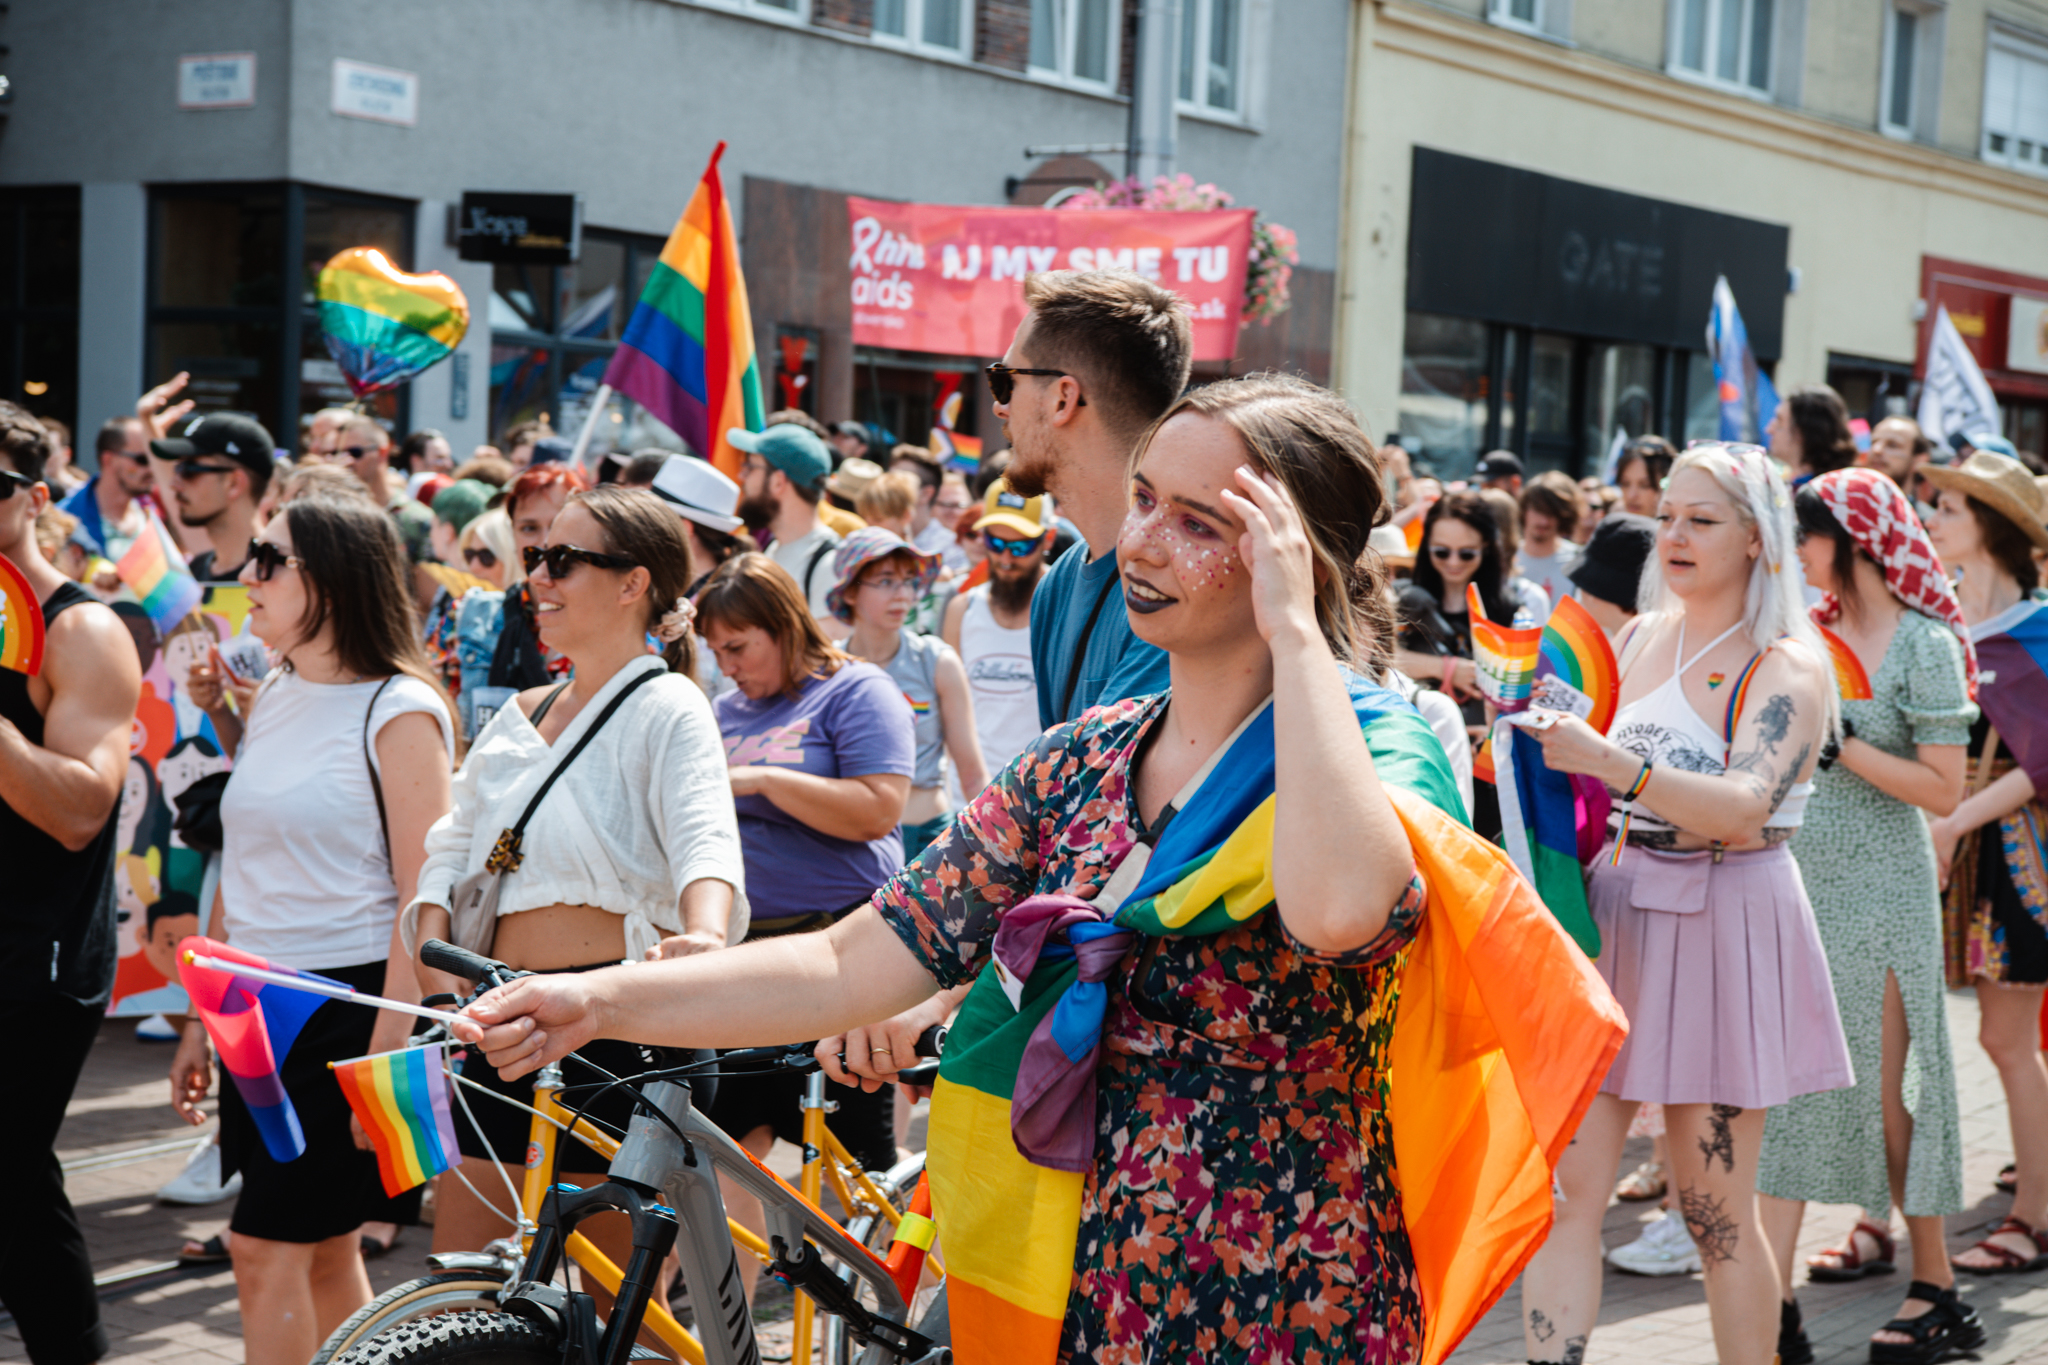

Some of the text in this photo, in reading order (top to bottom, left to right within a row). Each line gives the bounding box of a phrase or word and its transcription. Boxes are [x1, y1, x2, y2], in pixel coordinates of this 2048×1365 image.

[991, 245, 1058, 282] MY
[1068, 246, 1162, 281] SME
[1173, 246, 1228, 282] TU
[1561, 231, 1663, 296] GATE
[850, 270, 914, 310] aids
